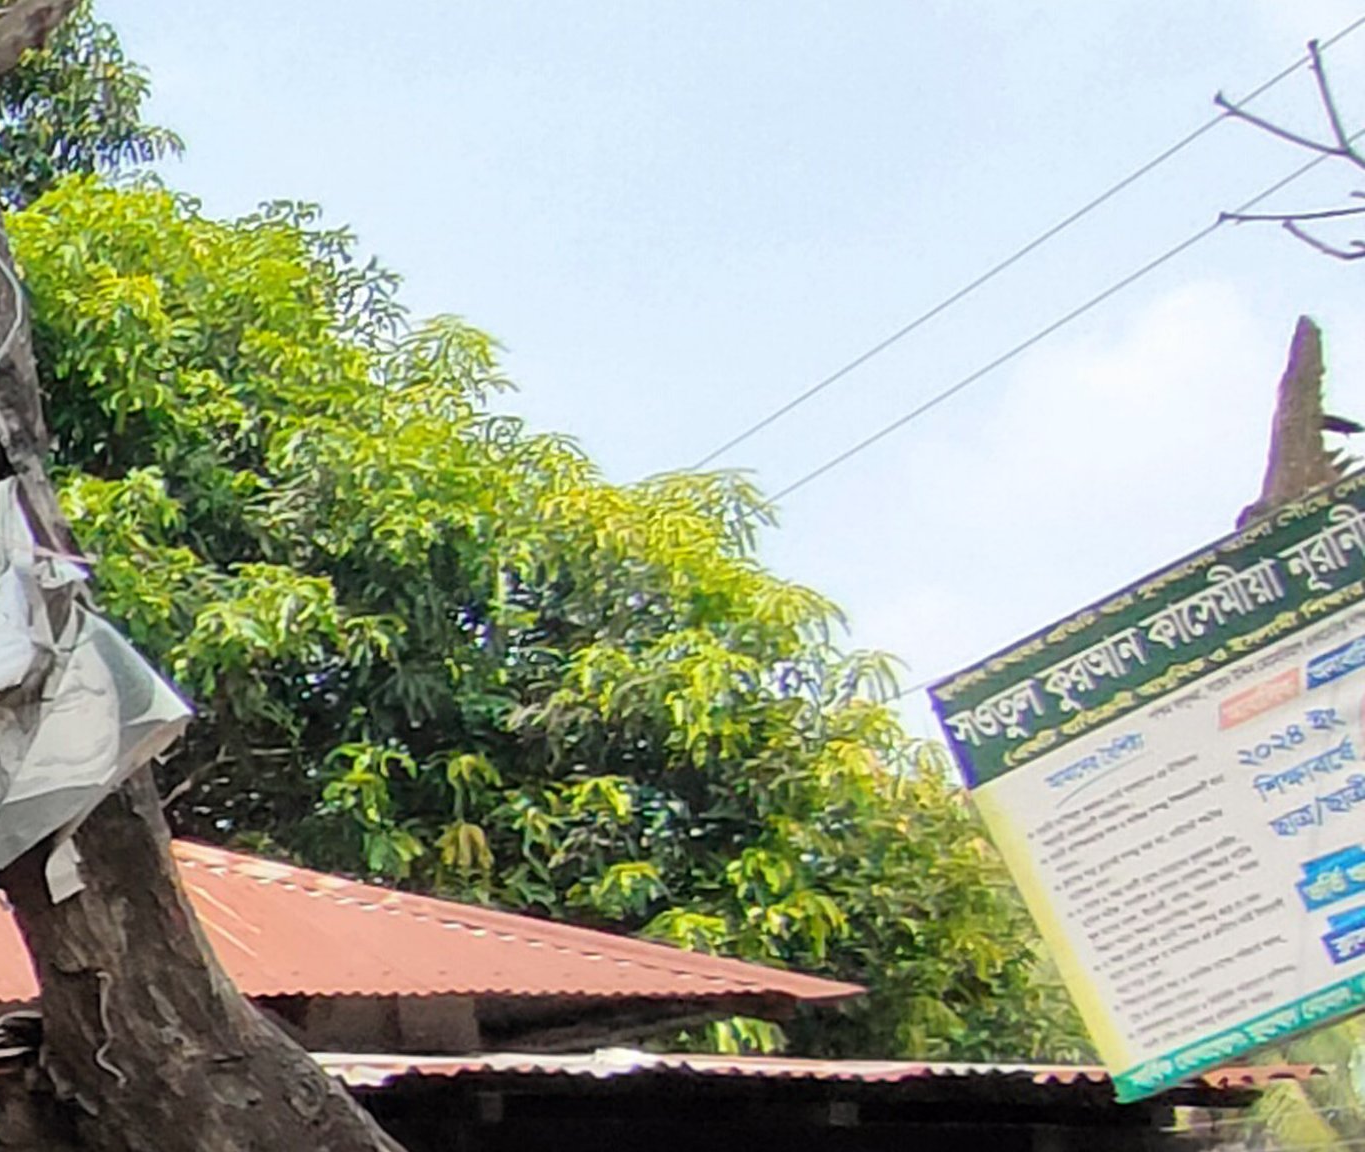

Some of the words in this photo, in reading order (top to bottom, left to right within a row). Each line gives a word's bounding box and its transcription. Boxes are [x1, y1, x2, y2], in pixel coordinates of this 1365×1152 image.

[944, 677, 1045, 747] সওতুল
[1033, 627, 1147, 712] কুরআন
[1138, 558, 1285, 651] কাসেমীয়া
[1236, 723, 1305, 767] ২০২৪
